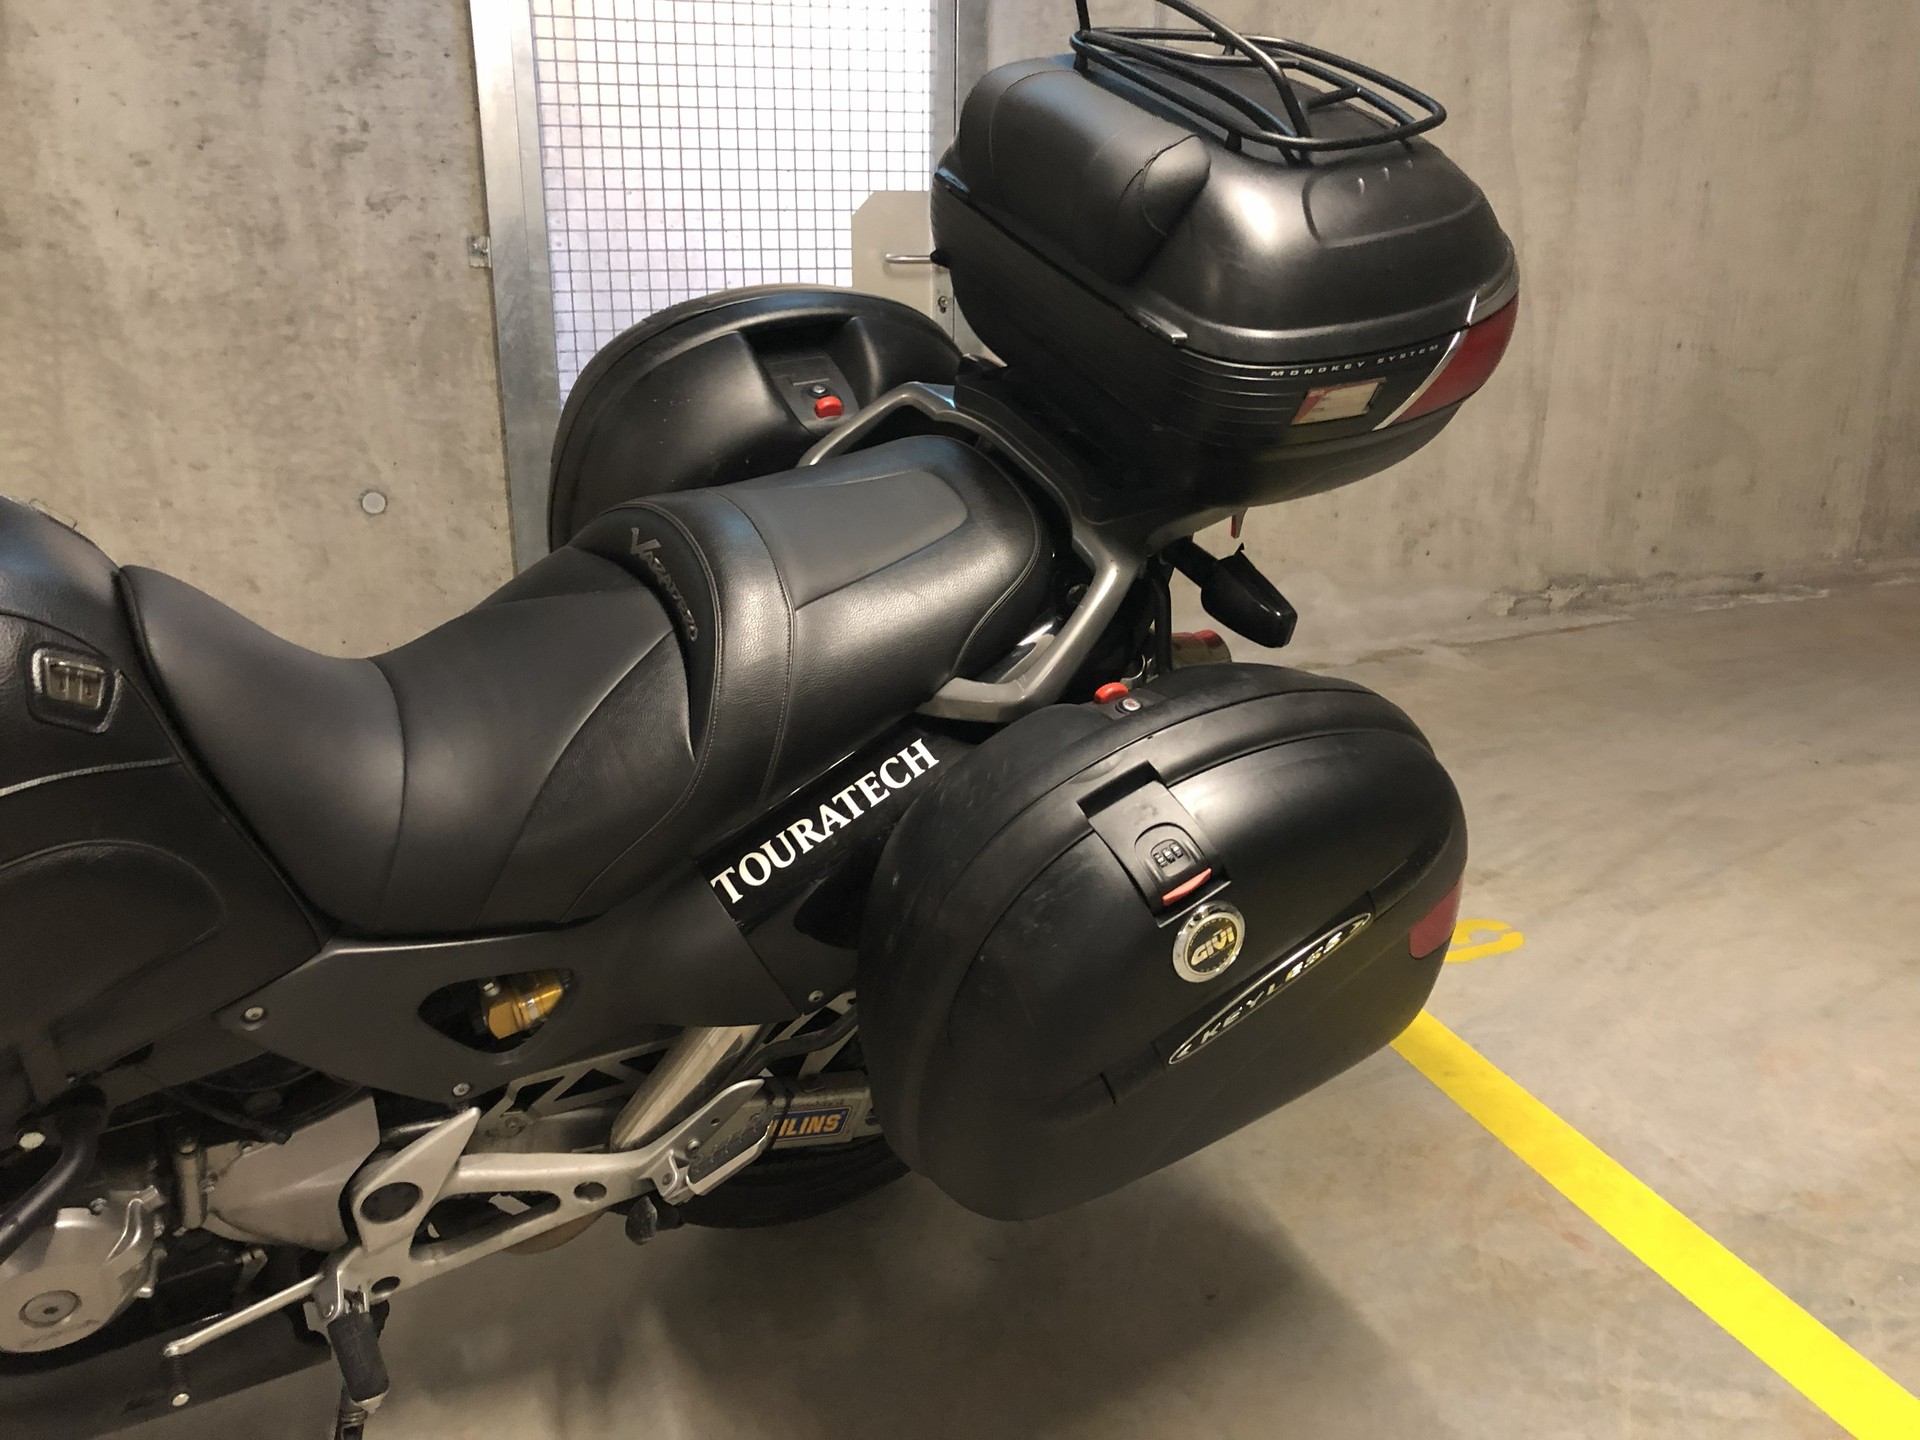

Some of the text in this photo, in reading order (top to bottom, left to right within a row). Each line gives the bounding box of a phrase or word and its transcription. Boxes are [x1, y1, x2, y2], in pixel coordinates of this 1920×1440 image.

[1270, 344, 1439, 377] MONOKEY SYSTEM
[710, 738, 939, 904] TOURATECH
[1191, 926, 1235, 966] GIVI
[1200, 931, 1343, 1044] KEYLESS
